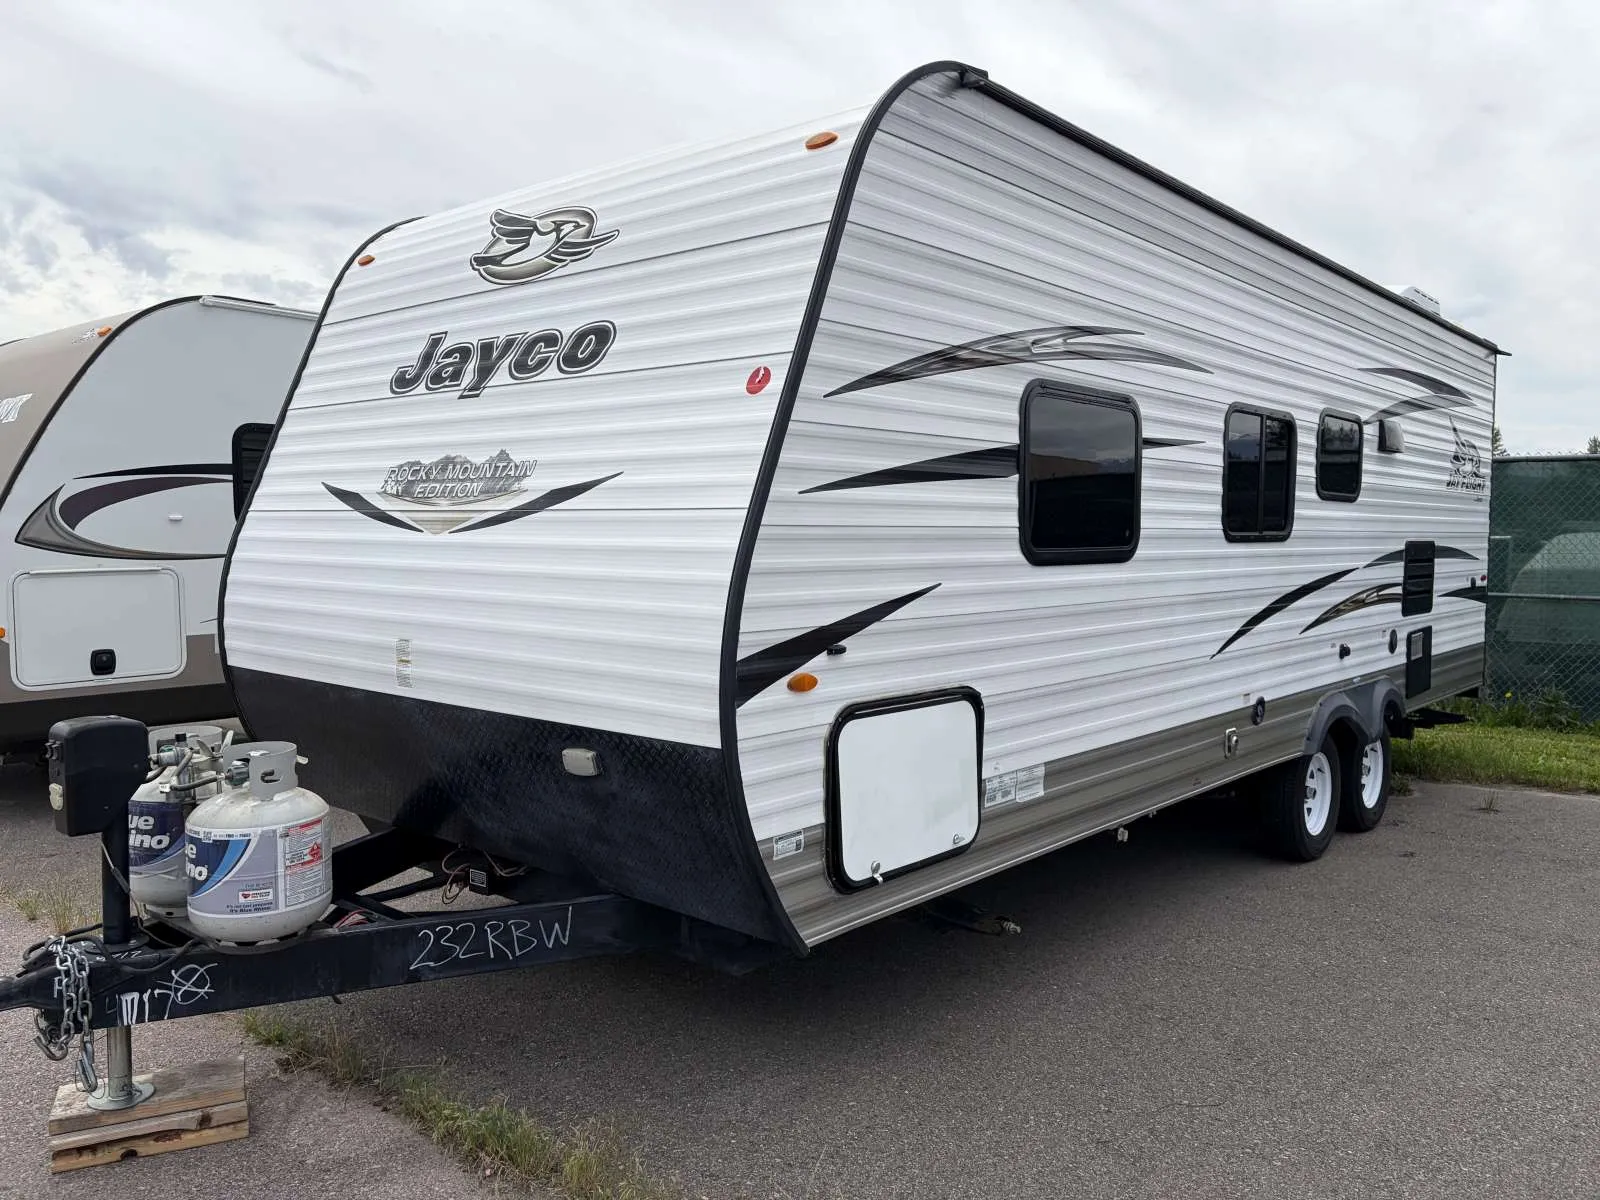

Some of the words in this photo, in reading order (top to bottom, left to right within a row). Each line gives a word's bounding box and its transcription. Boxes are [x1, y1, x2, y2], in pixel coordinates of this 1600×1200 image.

[390, 320, 617, 399] Jayco
[384, 464, 443, 481] ROCKY
[444, 460, 537, 480] MOUNTAIN
[414, 482, 483, 498] EDITION
[128, 815, 155, 830] ue
[128, 830, 170, 849] ino
[409, 905, 573, 970] 232RBW
